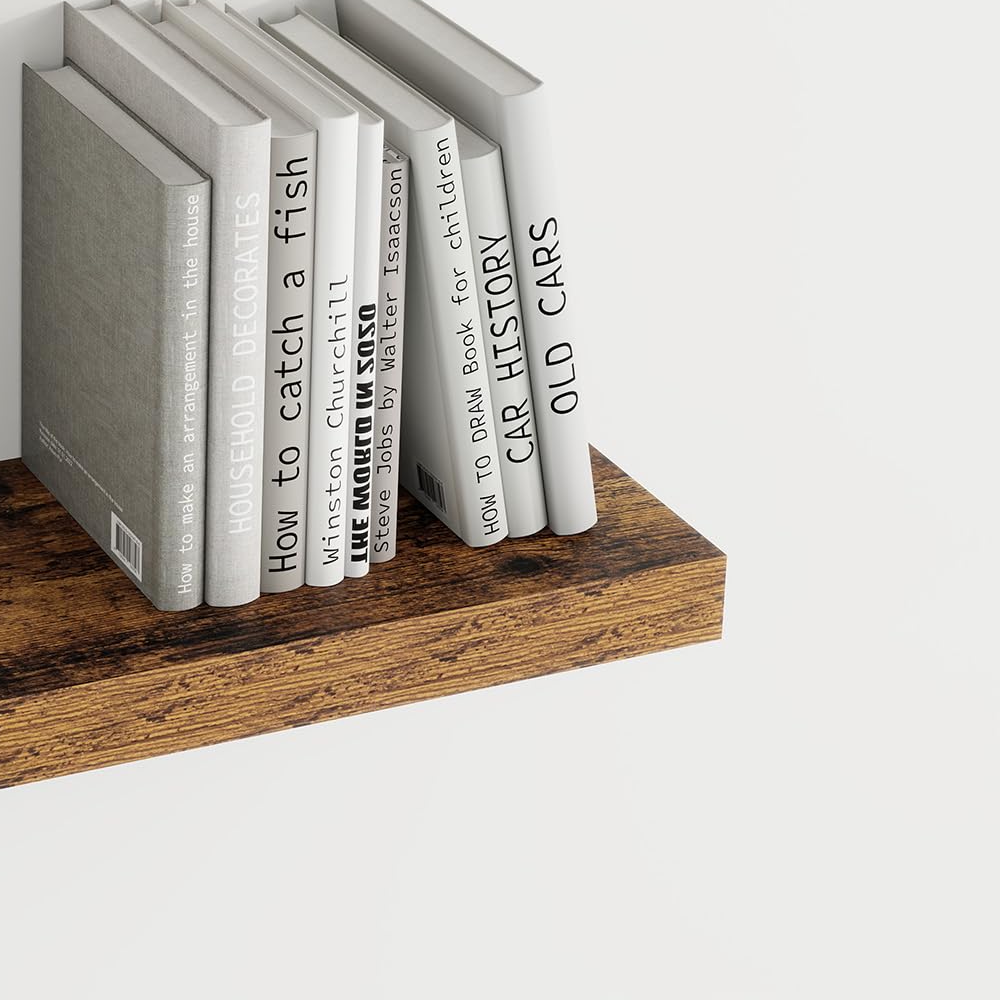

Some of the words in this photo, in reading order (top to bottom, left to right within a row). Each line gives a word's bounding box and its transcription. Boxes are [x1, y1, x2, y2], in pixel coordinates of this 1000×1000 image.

[182, 194, 199, 248] house
[273, 156, 308, 244] fish
[383, 168, 402, 277] Isaacson
[436, 137, 463, 250] children
[182, 258, 198, 289] the
[232, 191, 261, 357] DECORATES
[283, 269, 305, 289] a
[451, 267, 469, 306] for
[528, 216, 567, 317] CARS
[181, 299, 197, 320] in
[380, 292, 398, 373] Walter
[478, 234, 525, 382] HISTORY
[271, 313, 304, 421] catch
[325, 274, 349, 429] Churchill
[456, 318, 479, 376] Book
[182, 330, 199, 443] arrangement
[377, 385, 397, 410] by
[544, 342, 579, 415] OLD
[465, 387, 488, 443] DRAW
[501, 397, 535, 464] CAR
[183, 452, 195, 473] an
[229, 375, 256, 534] HOUSEHOLD
[271, 446, 301, 487] to
[376, 424, 394, 474] Jobs
[474, 455, 493, 484] TO
[178, 483, 194, 525] make
[321, 446, 342, 566] Winston
[374, 488, 391, 553] Steve
[479, 494, 500, 536] HOW
[179, 534, 193, 554] to
[268, 510, 299, 573] How
[177, 563, 193, 595] How
